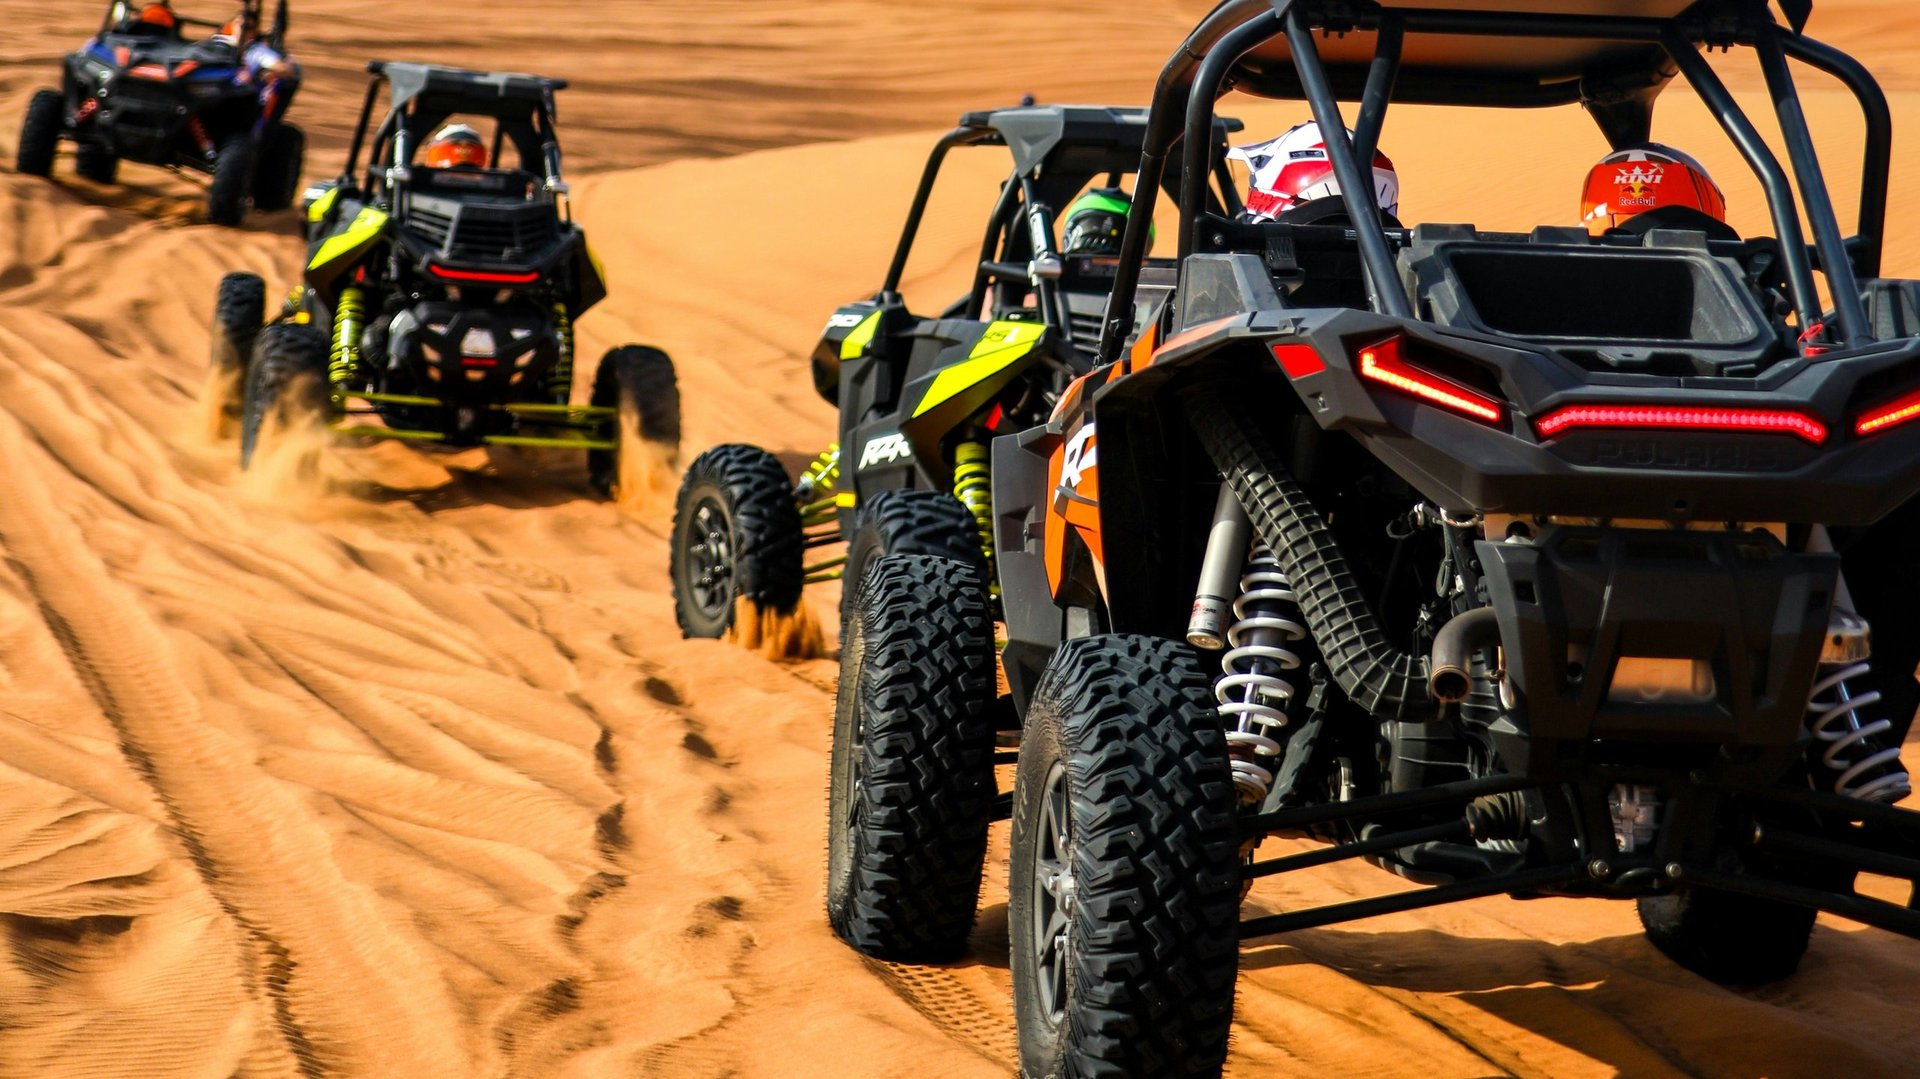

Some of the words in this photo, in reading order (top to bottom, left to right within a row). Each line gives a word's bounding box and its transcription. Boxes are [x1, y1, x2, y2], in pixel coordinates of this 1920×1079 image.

[1613, 174, 1663, 185] KINI
[1619, 197, 1636, 206] Red
[1638, 196, 1656, 206] Bull
[1593, 440, 1778, 469] POLARIS
